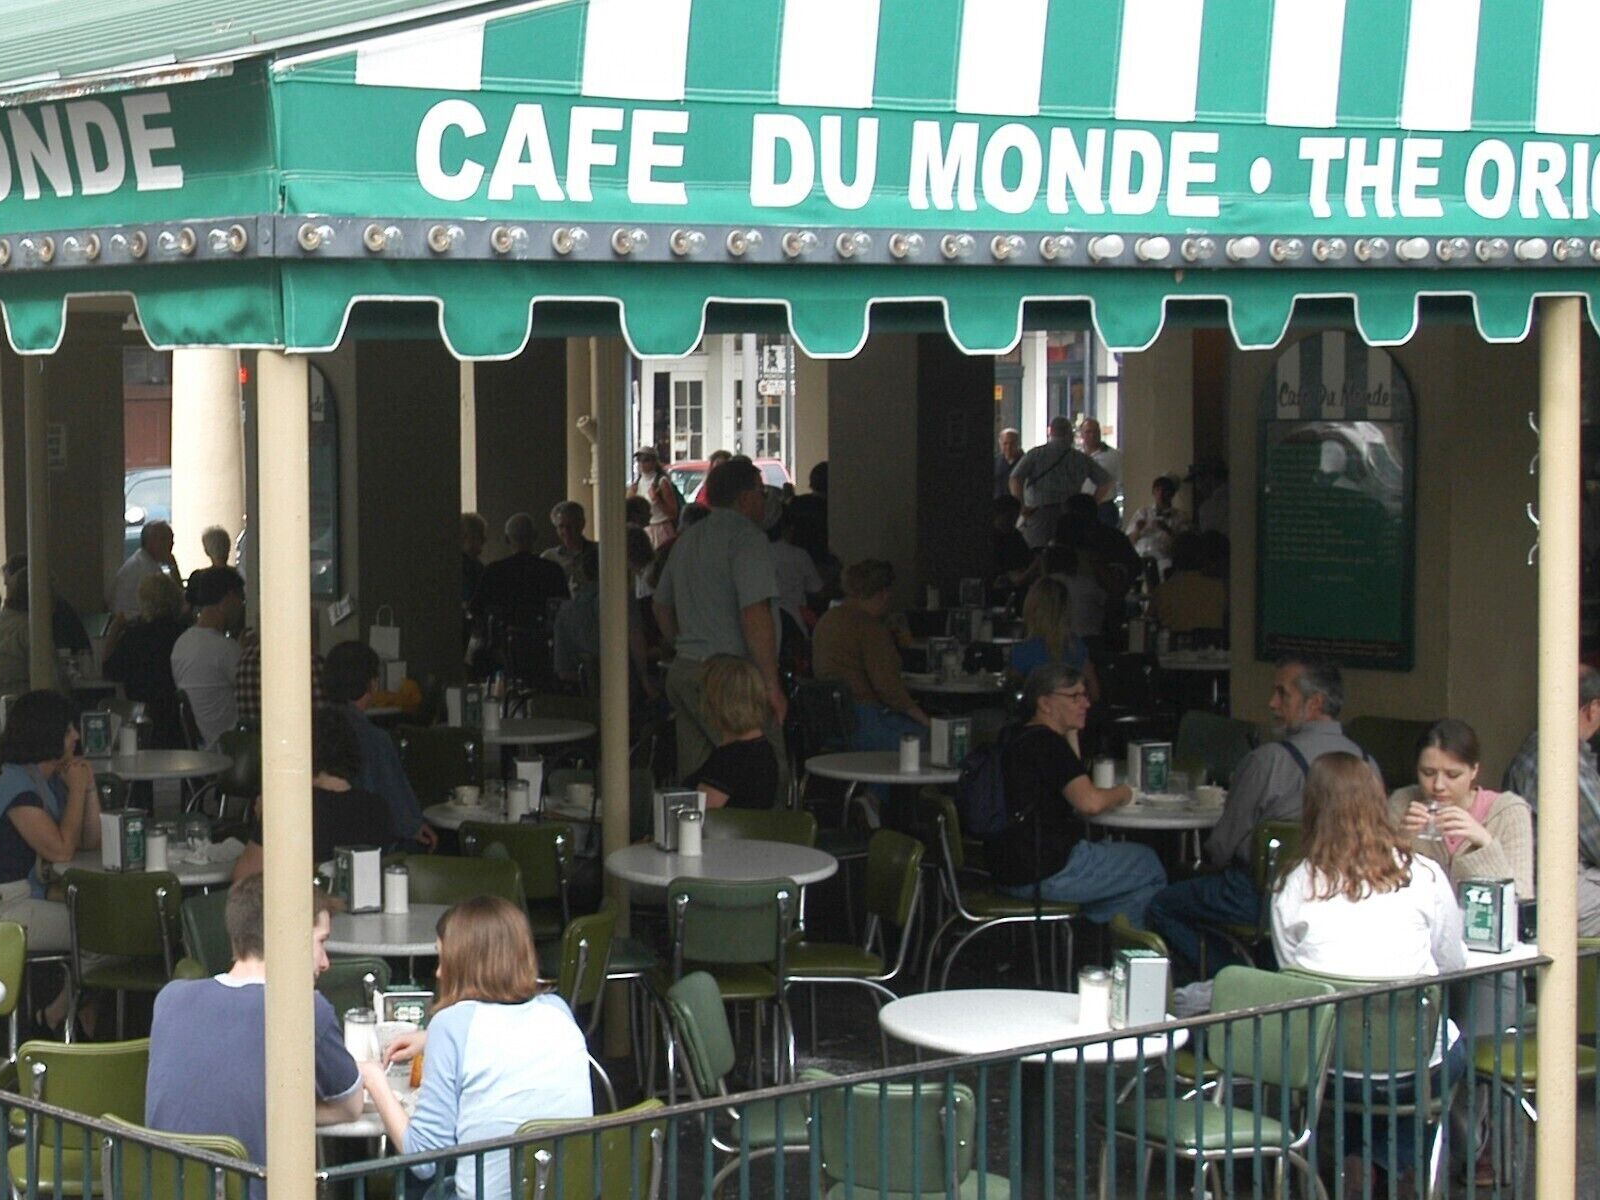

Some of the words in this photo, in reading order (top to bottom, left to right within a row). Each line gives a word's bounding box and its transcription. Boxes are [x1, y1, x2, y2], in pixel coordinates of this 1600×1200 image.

[415, 98, 690, 205] CAFE
[749, 112, 880, 210] DU
[908, 120, 1221, 218] MONDE
[1299, 136, 1444, 219] THE
[1464, 139, 1600, 220] ORI
